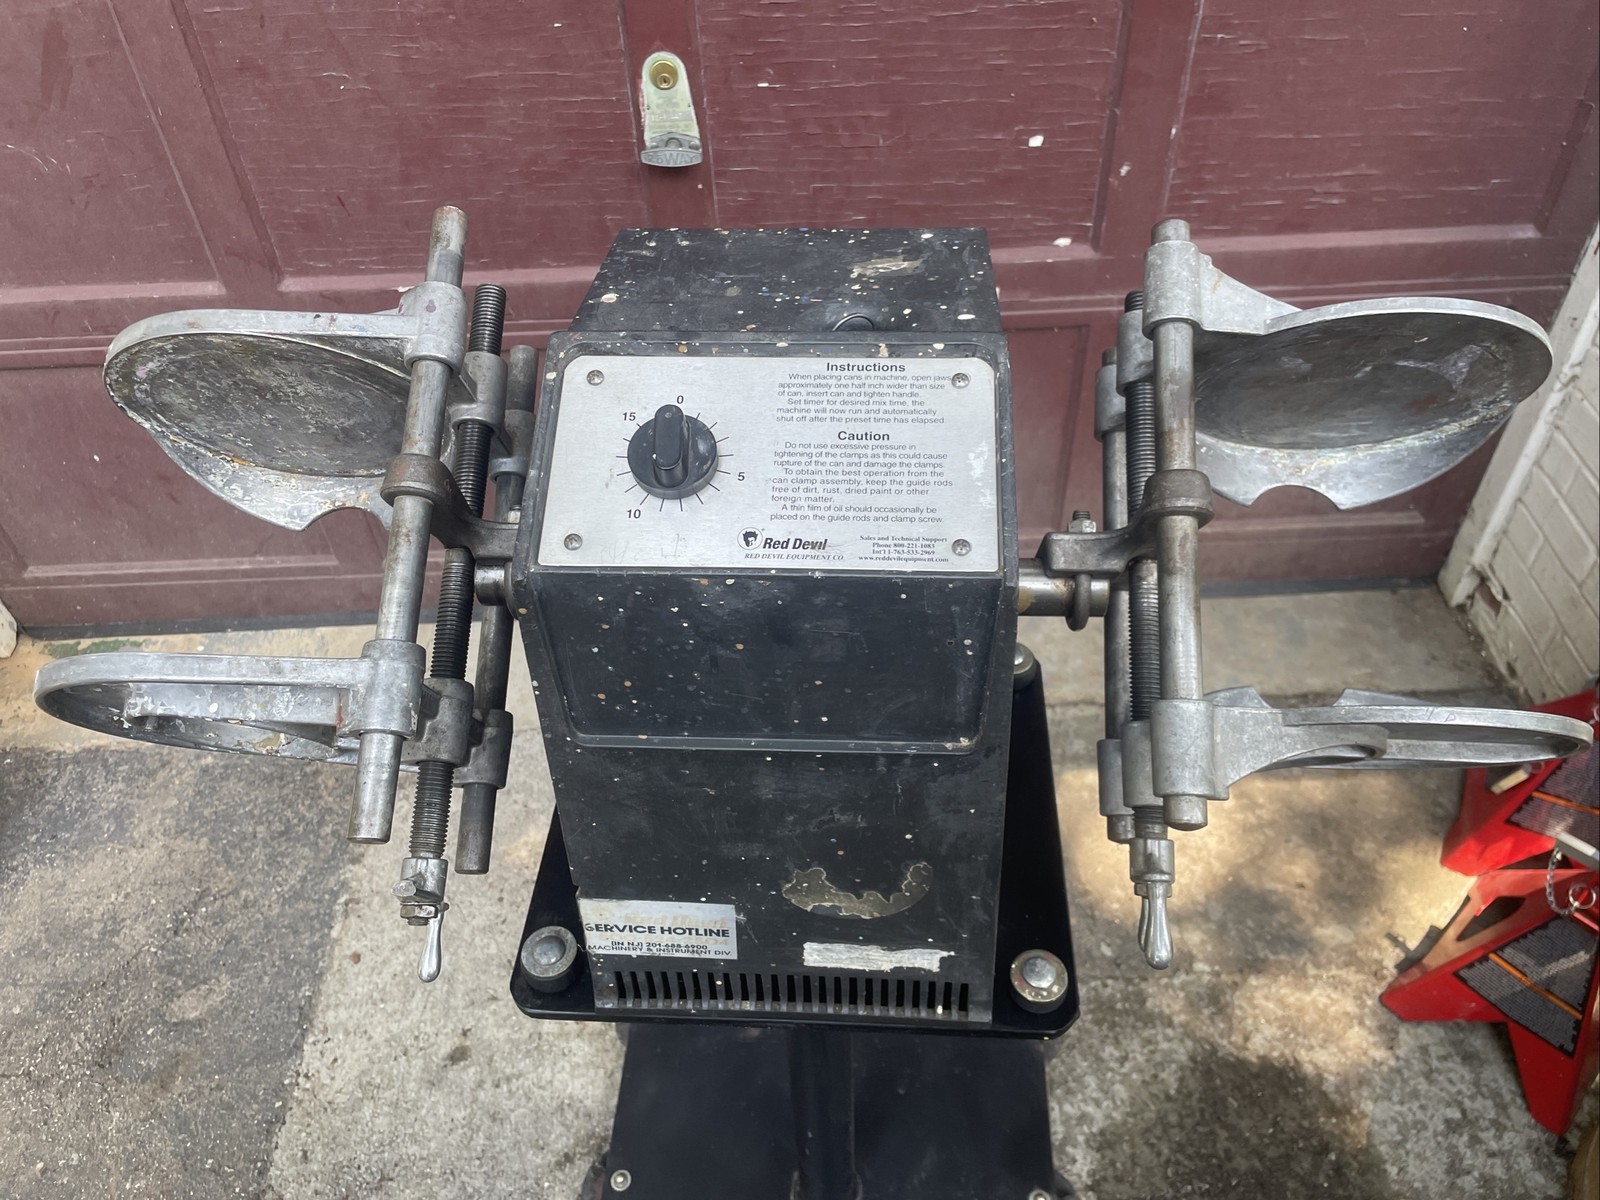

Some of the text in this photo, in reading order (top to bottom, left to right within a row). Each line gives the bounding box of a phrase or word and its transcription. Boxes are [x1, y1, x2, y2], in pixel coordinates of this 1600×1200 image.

[827, 362, 906, 372] Instructions
[676, 395, 684, 404] 0
[622, 412, 636, 421] 15
[838, 431, 890, 441] Caution
[737, 472, 745, 481] 5
[627, 509, 641, 518] 10
[874, 506, 924, 514] occasionally
[763, 538, 828, 550] Red Devil
[585, 923, 730, 937] SERVICE HOTLINE
